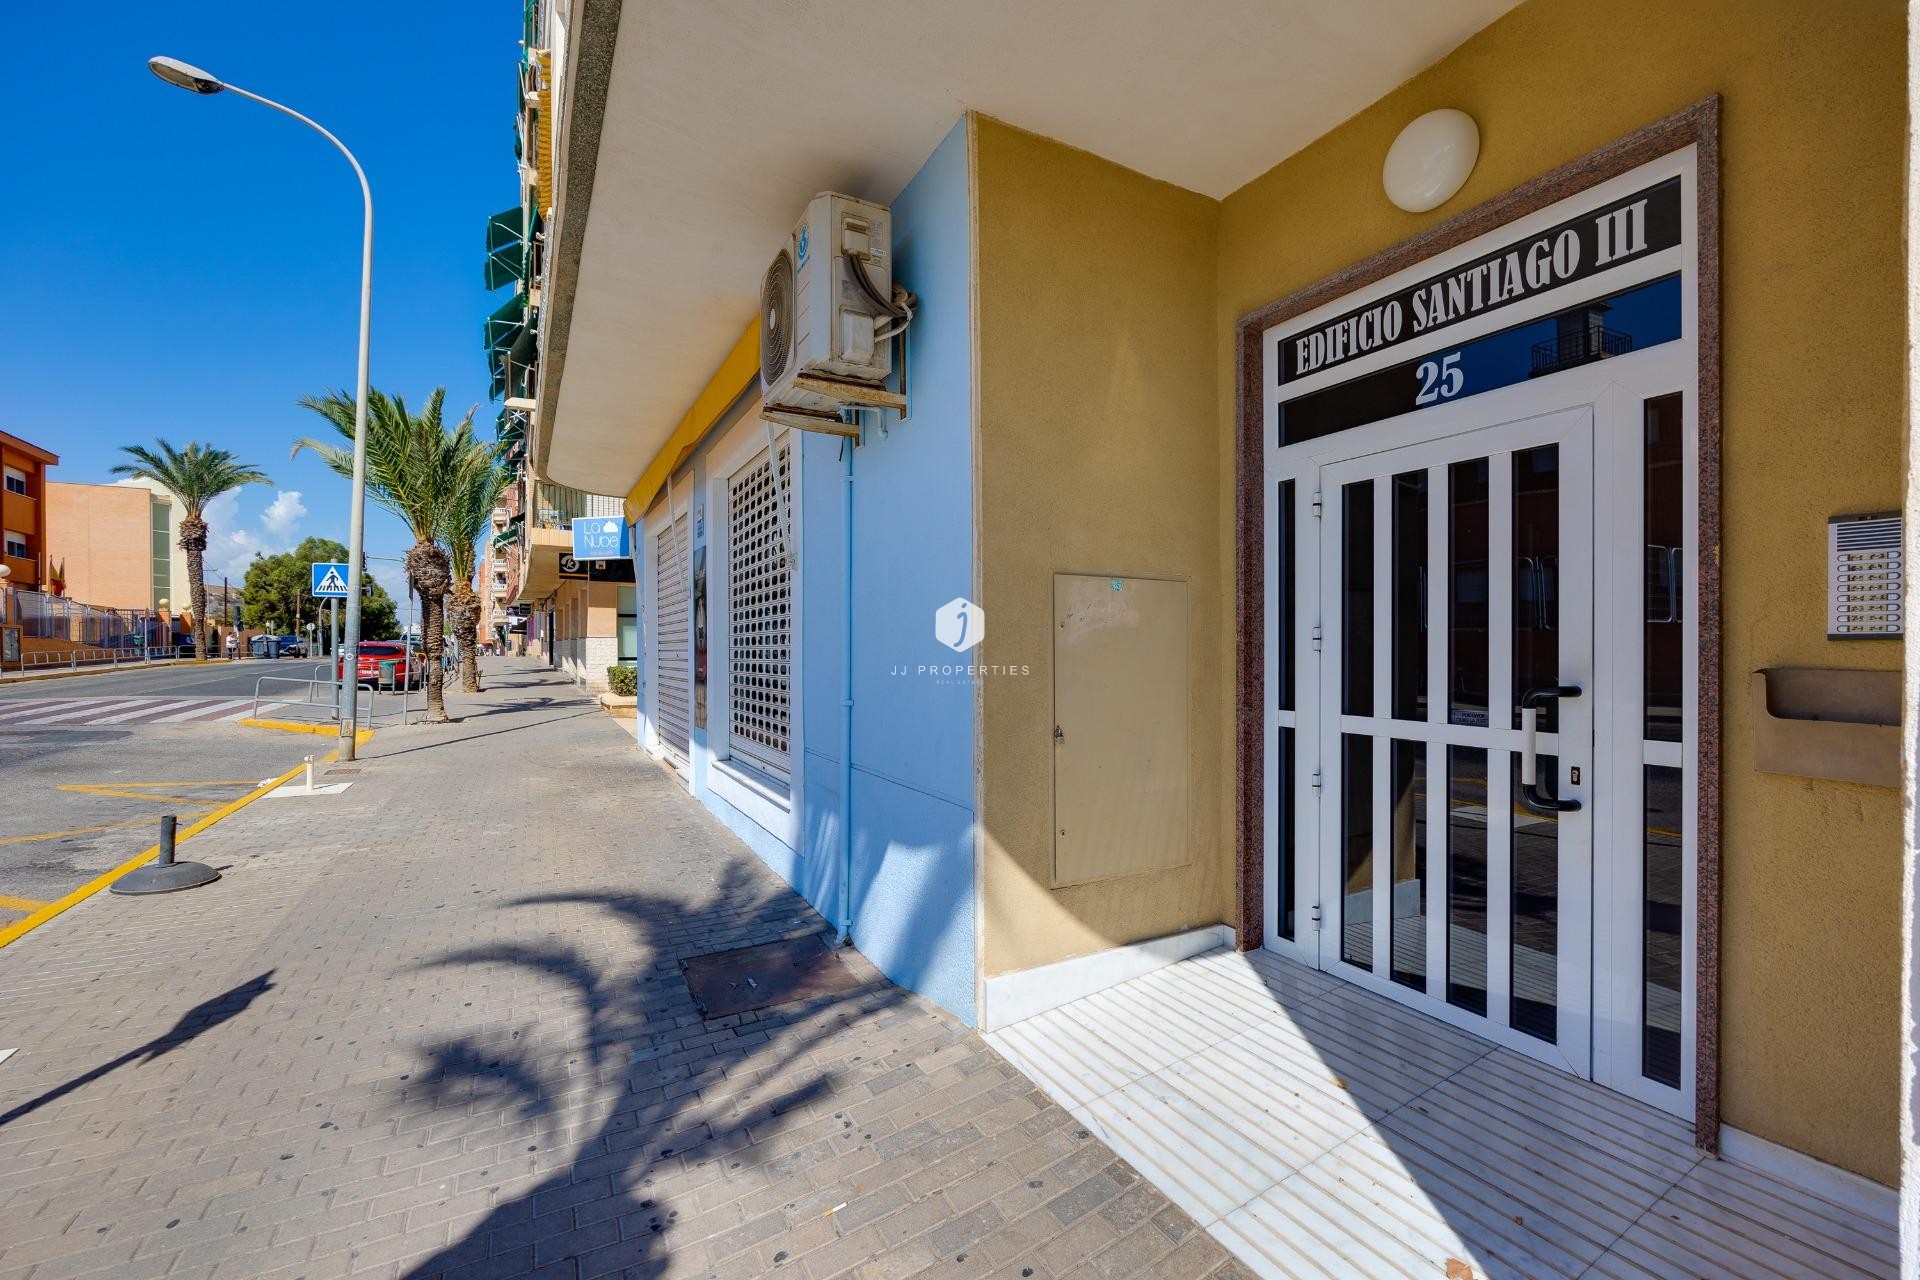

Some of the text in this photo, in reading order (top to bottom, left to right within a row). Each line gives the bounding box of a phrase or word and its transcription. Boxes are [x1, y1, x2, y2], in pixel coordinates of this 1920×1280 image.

[1295, 198, 1649, 377] EDIFICIO SANTIAGO III
[1414, 351, 1465, 407] 25
